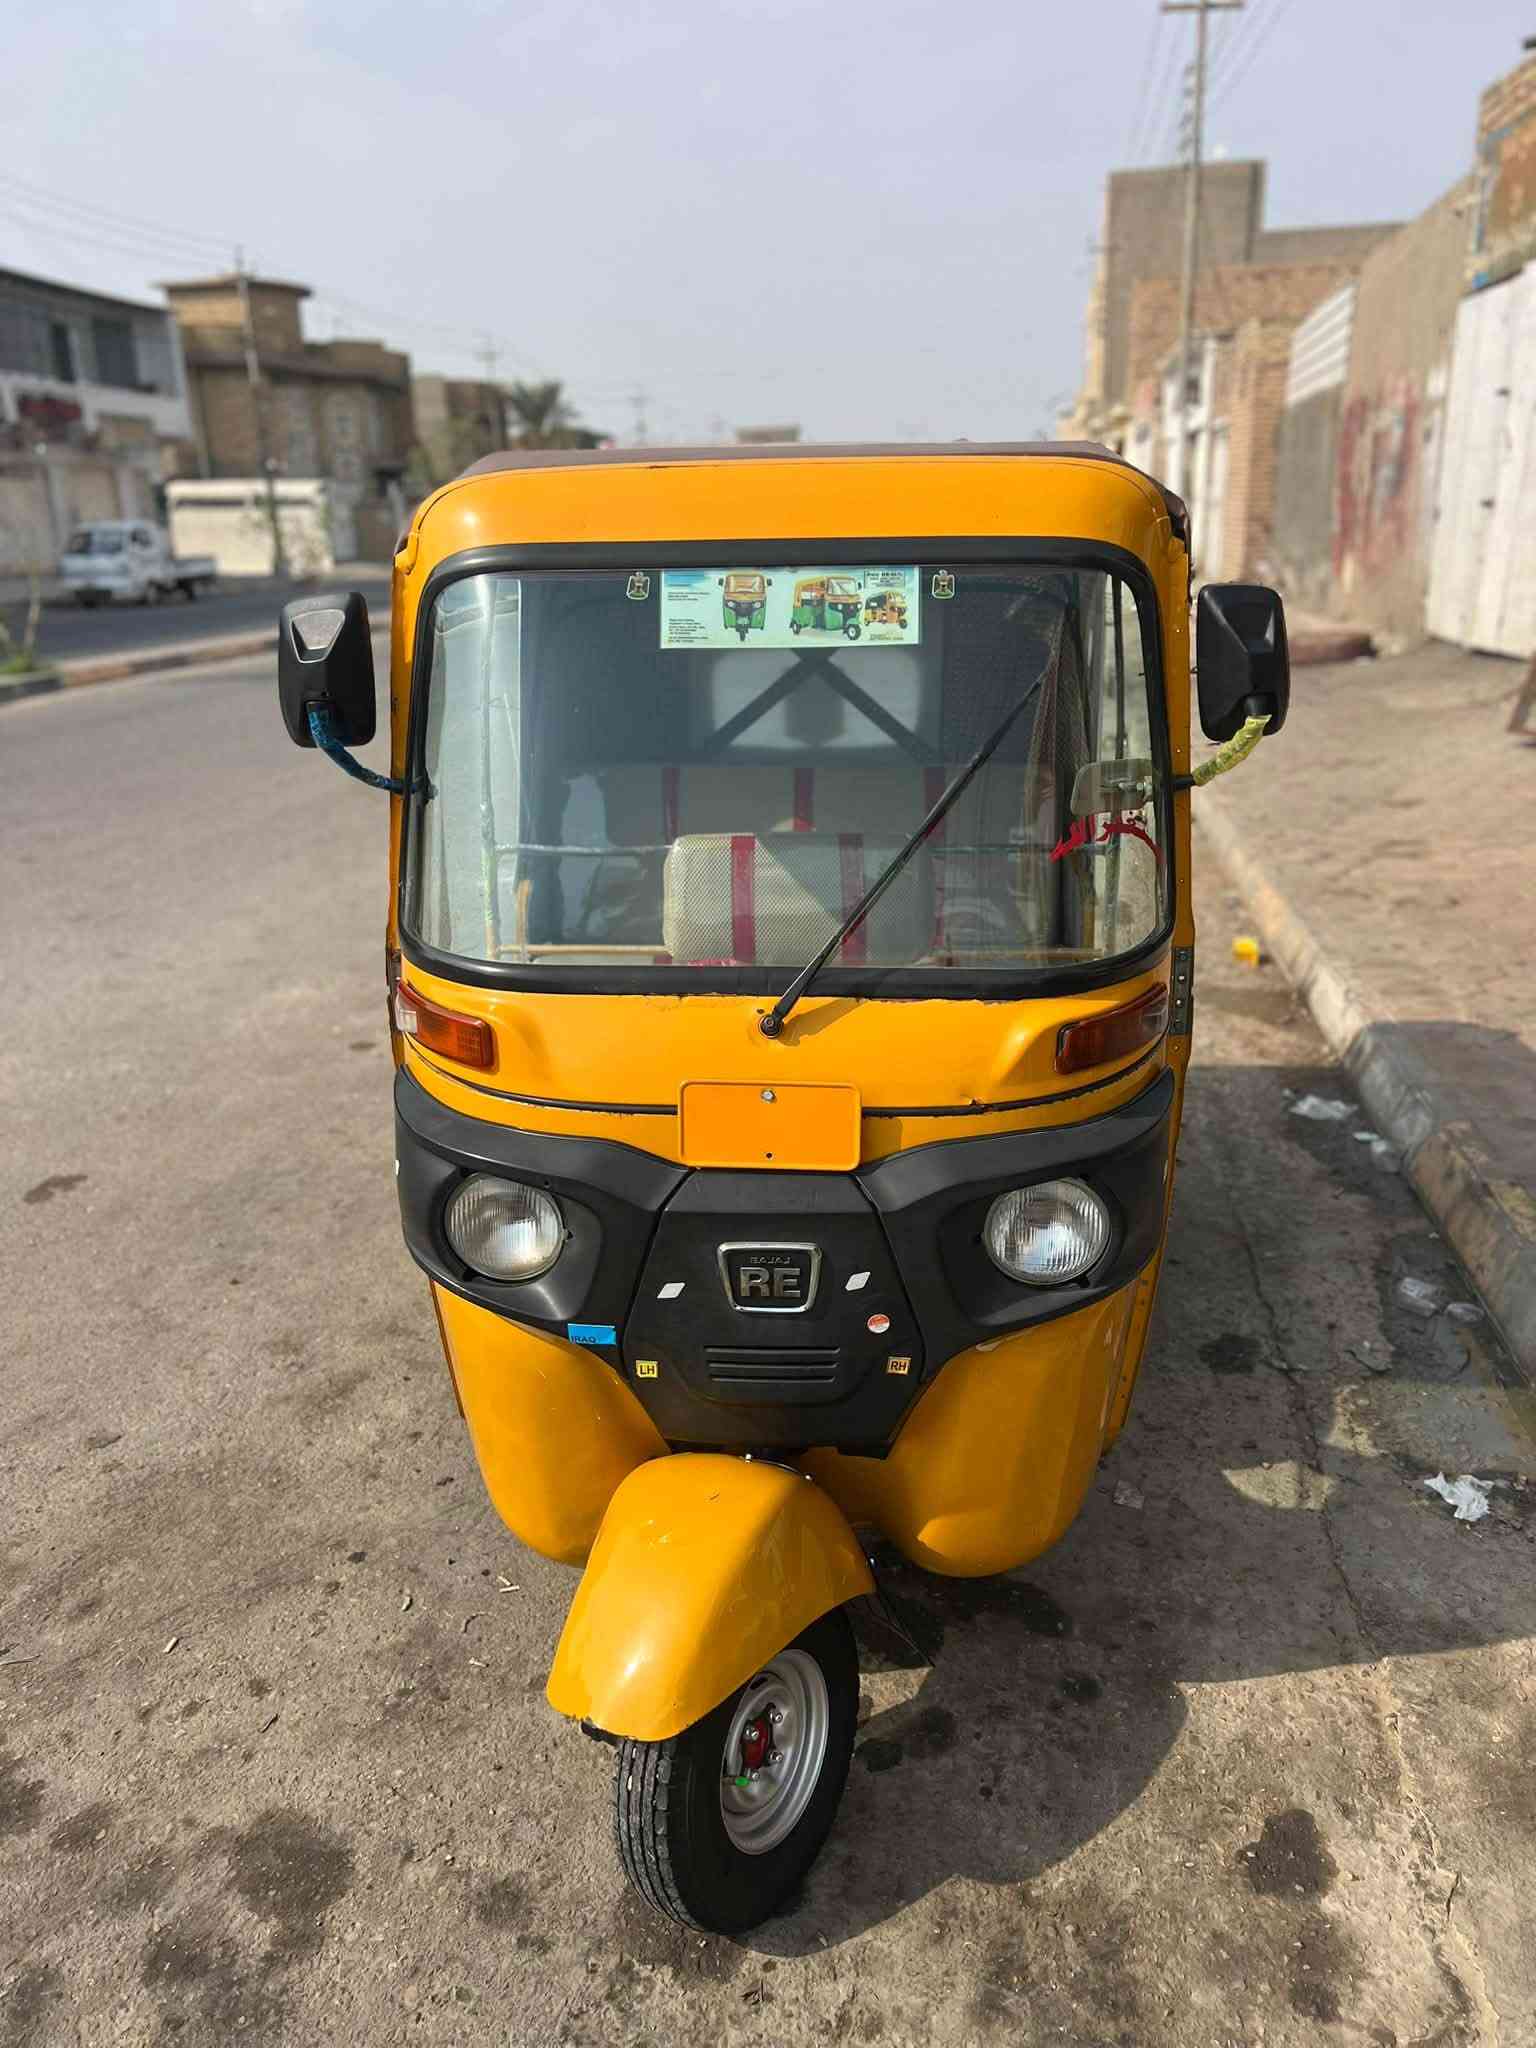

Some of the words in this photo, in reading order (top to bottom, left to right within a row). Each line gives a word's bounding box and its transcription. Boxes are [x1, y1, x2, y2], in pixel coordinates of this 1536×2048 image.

[740, 1267, 801, 1297] RE
[571, 1335, 597, 1344] IRAQ
[640, 1364, 655, 1375] LH
[891, 1361, 907, 1371] RH
